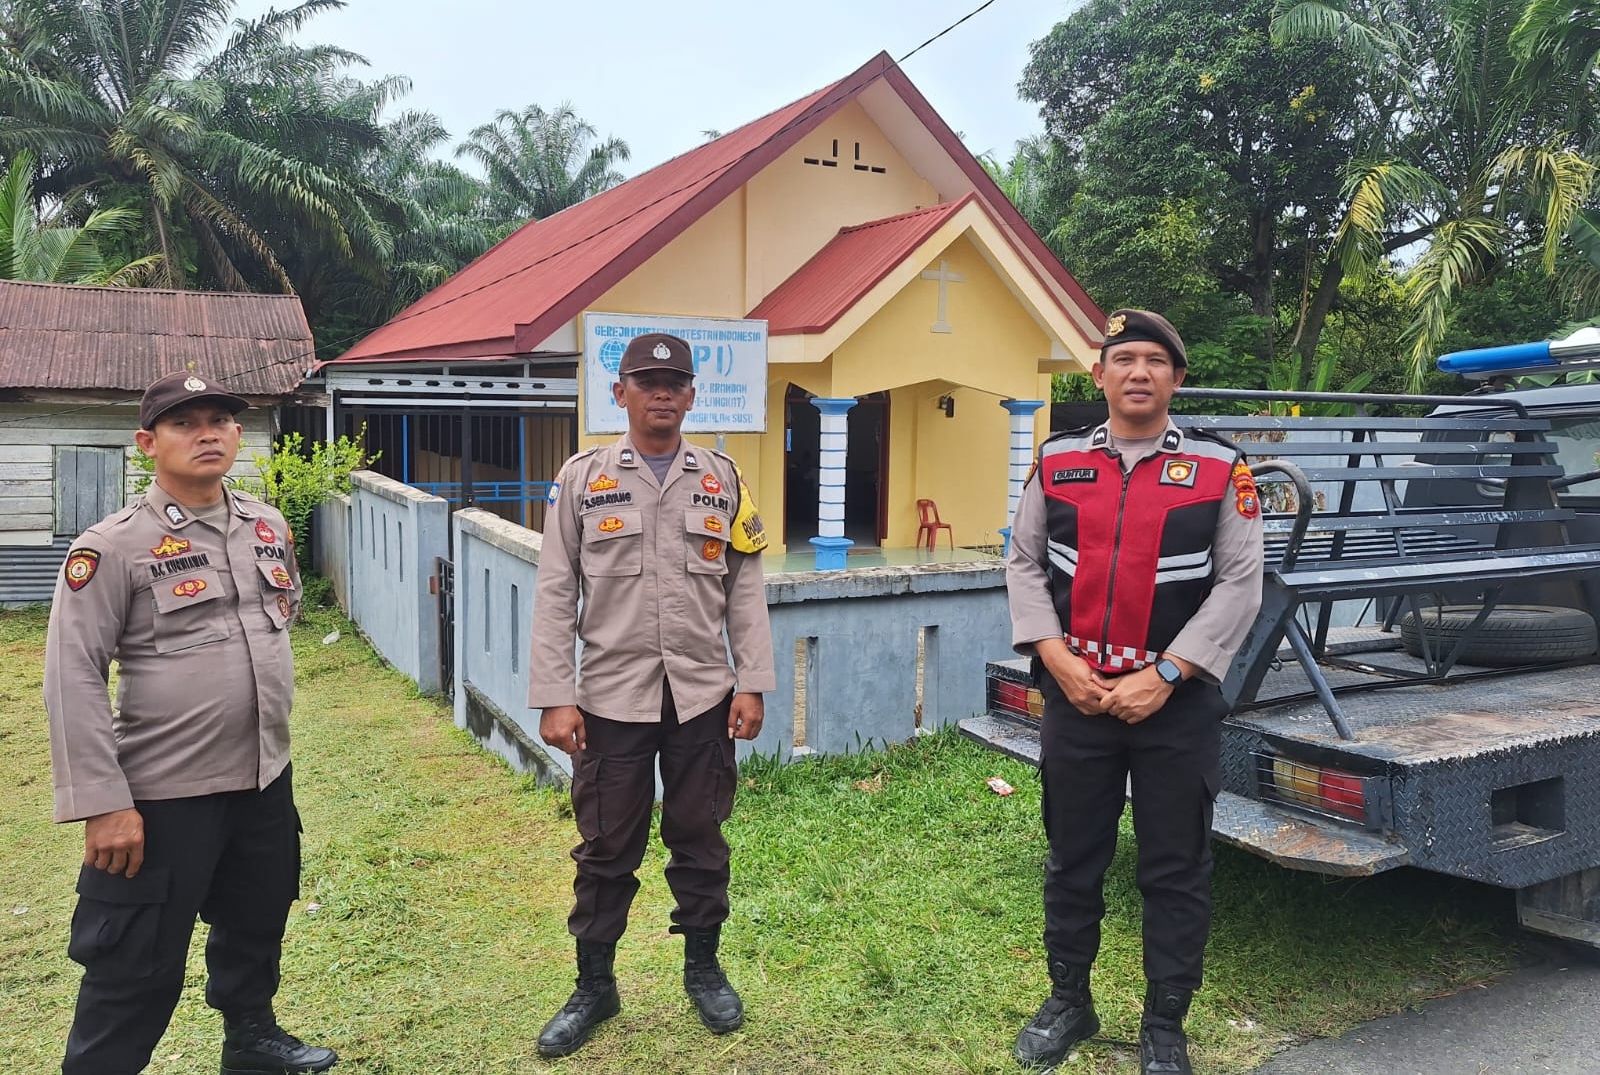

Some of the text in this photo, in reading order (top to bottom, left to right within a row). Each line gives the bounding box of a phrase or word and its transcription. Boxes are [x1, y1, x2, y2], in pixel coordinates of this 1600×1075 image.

[594, 325, 629, 337] GEREJA
[717, 330, 760, 342] INDONESIA
[693, 493, 729, 511] POLRI
